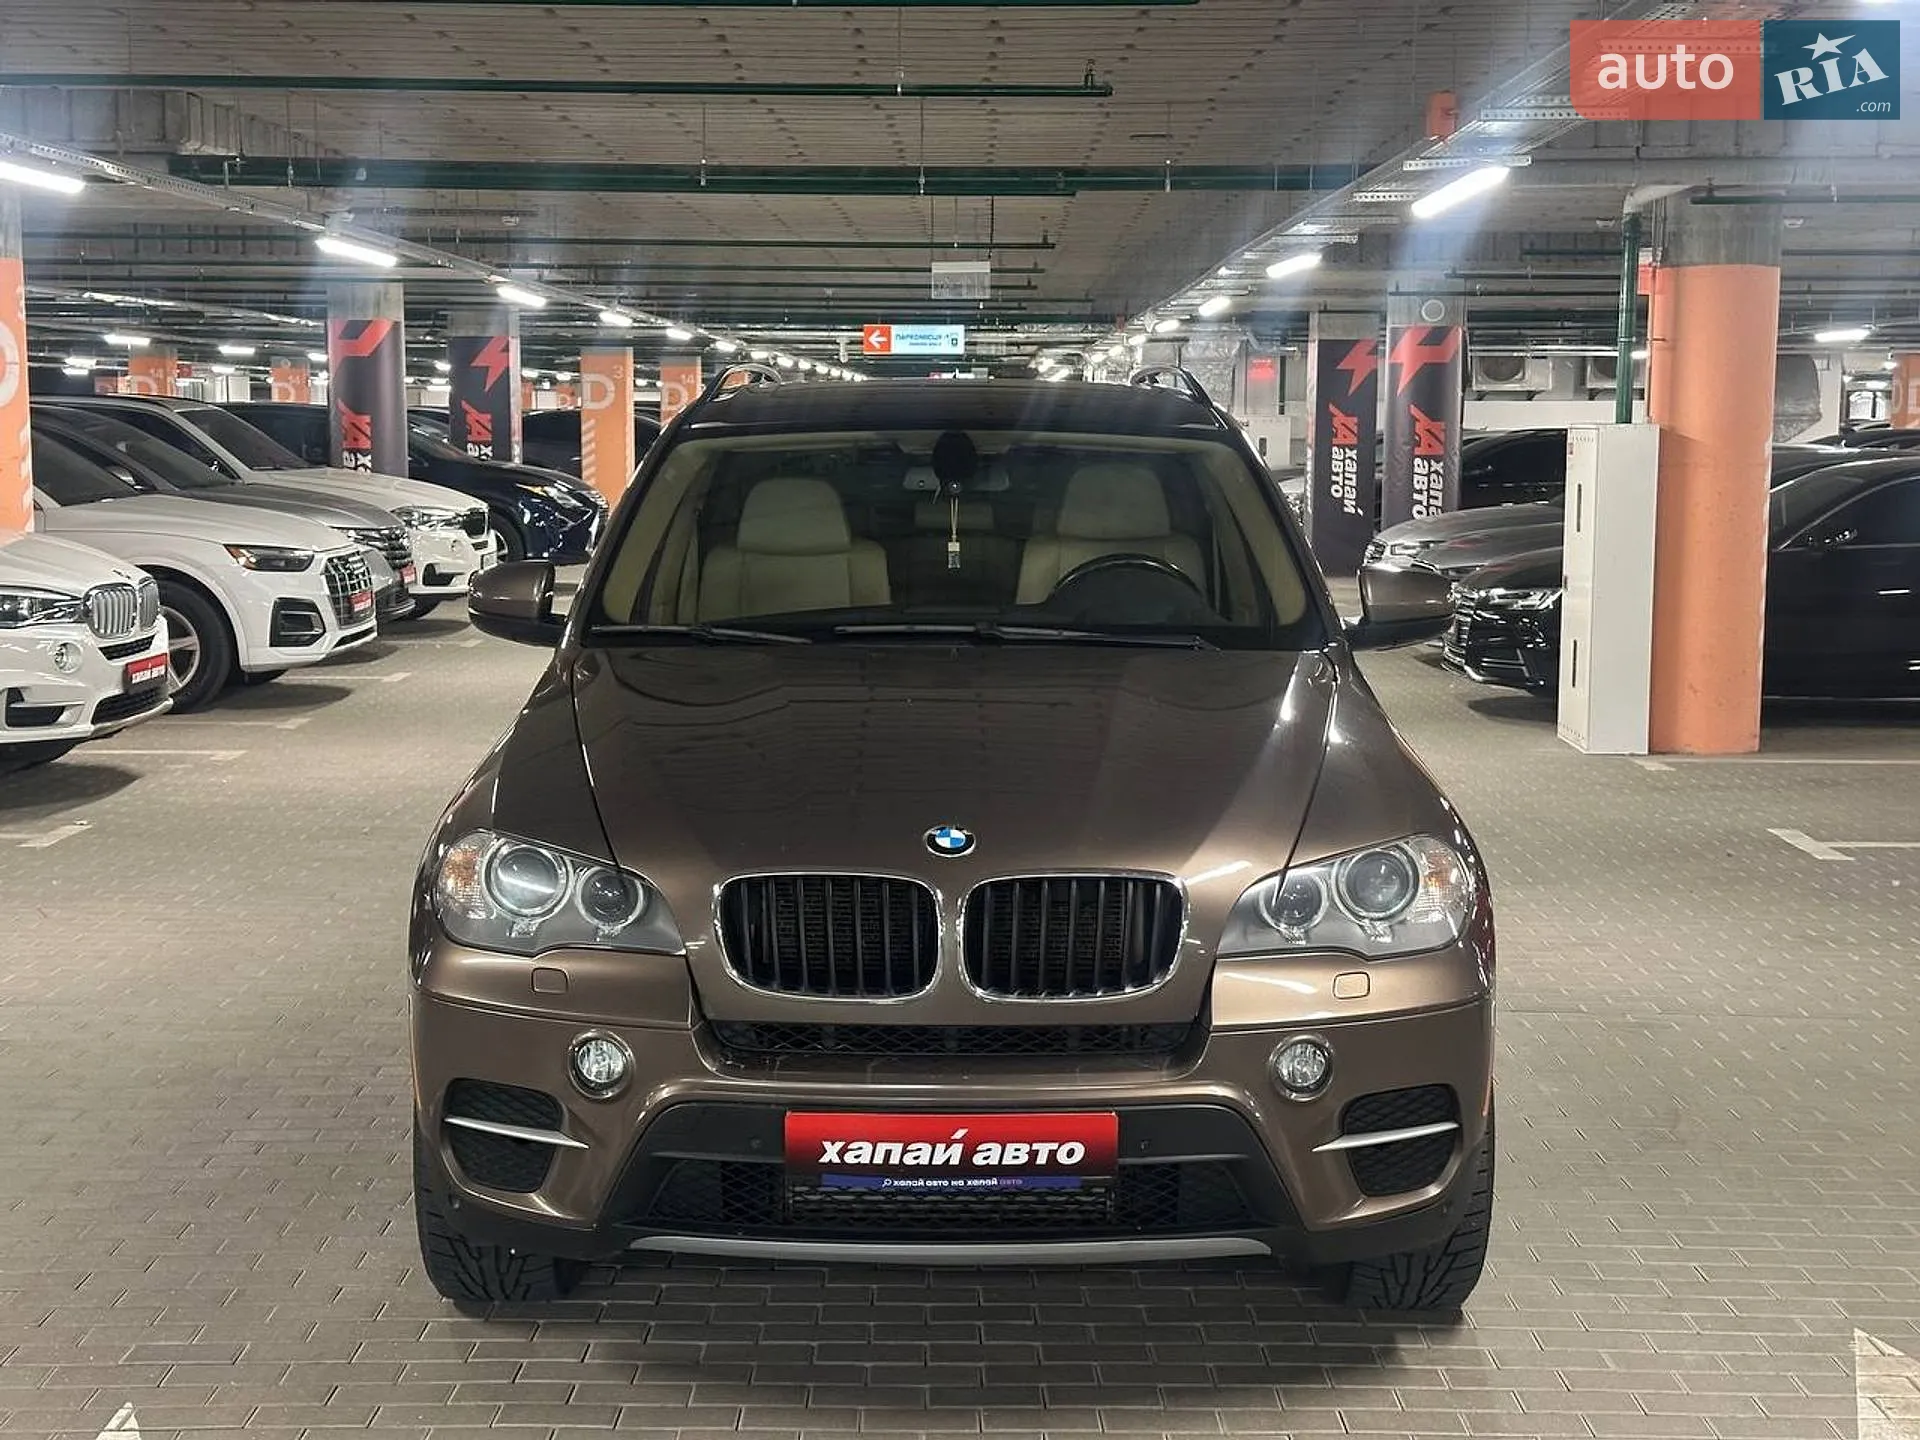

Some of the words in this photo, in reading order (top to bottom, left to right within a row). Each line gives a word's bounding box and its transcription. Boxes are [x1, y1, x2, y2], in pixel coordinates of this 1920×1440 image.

[581, 373, 615, 410] D
[612, 364, 625, 380] 3
[661, 382, 688, 411] D
[1331, 446, 1344, 499] авто
[1344, 447, 1364, 517] хапай
[1412, 457, 1429, 520] авто
[818, 1128, 969, 1166] хапай
[972, 1141, 1086, 1167] авто
[893, 1178, 925, 1187] хапай
[925, 1179, 949, 1187] авто
[951, 1179, 965, 1187] на
[966, 1177, 998, 1186] хапай
